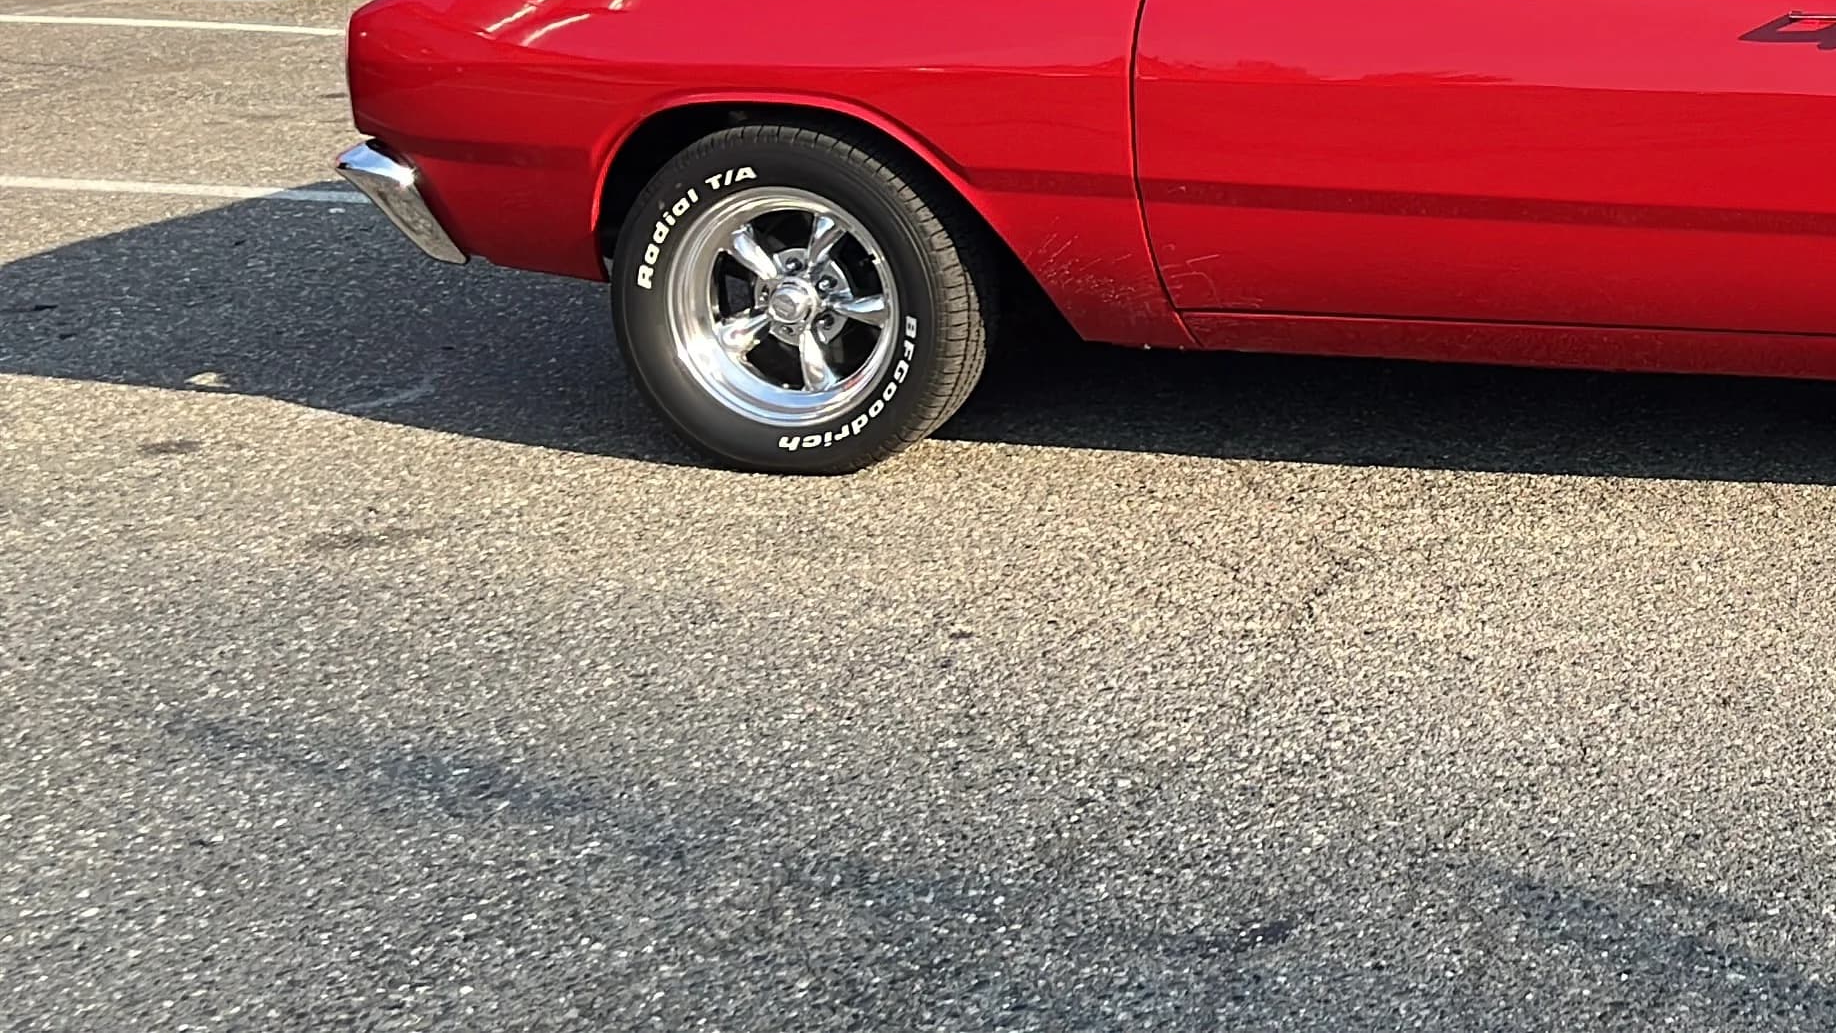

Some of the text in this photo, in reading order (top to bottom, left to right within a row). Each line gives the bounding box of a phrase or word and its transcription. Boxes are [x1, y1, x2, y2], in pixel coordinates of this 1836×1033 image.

[637, 164, 758, 291] Radial T/A
[779, 315, 918, 452] BFGoodrich
